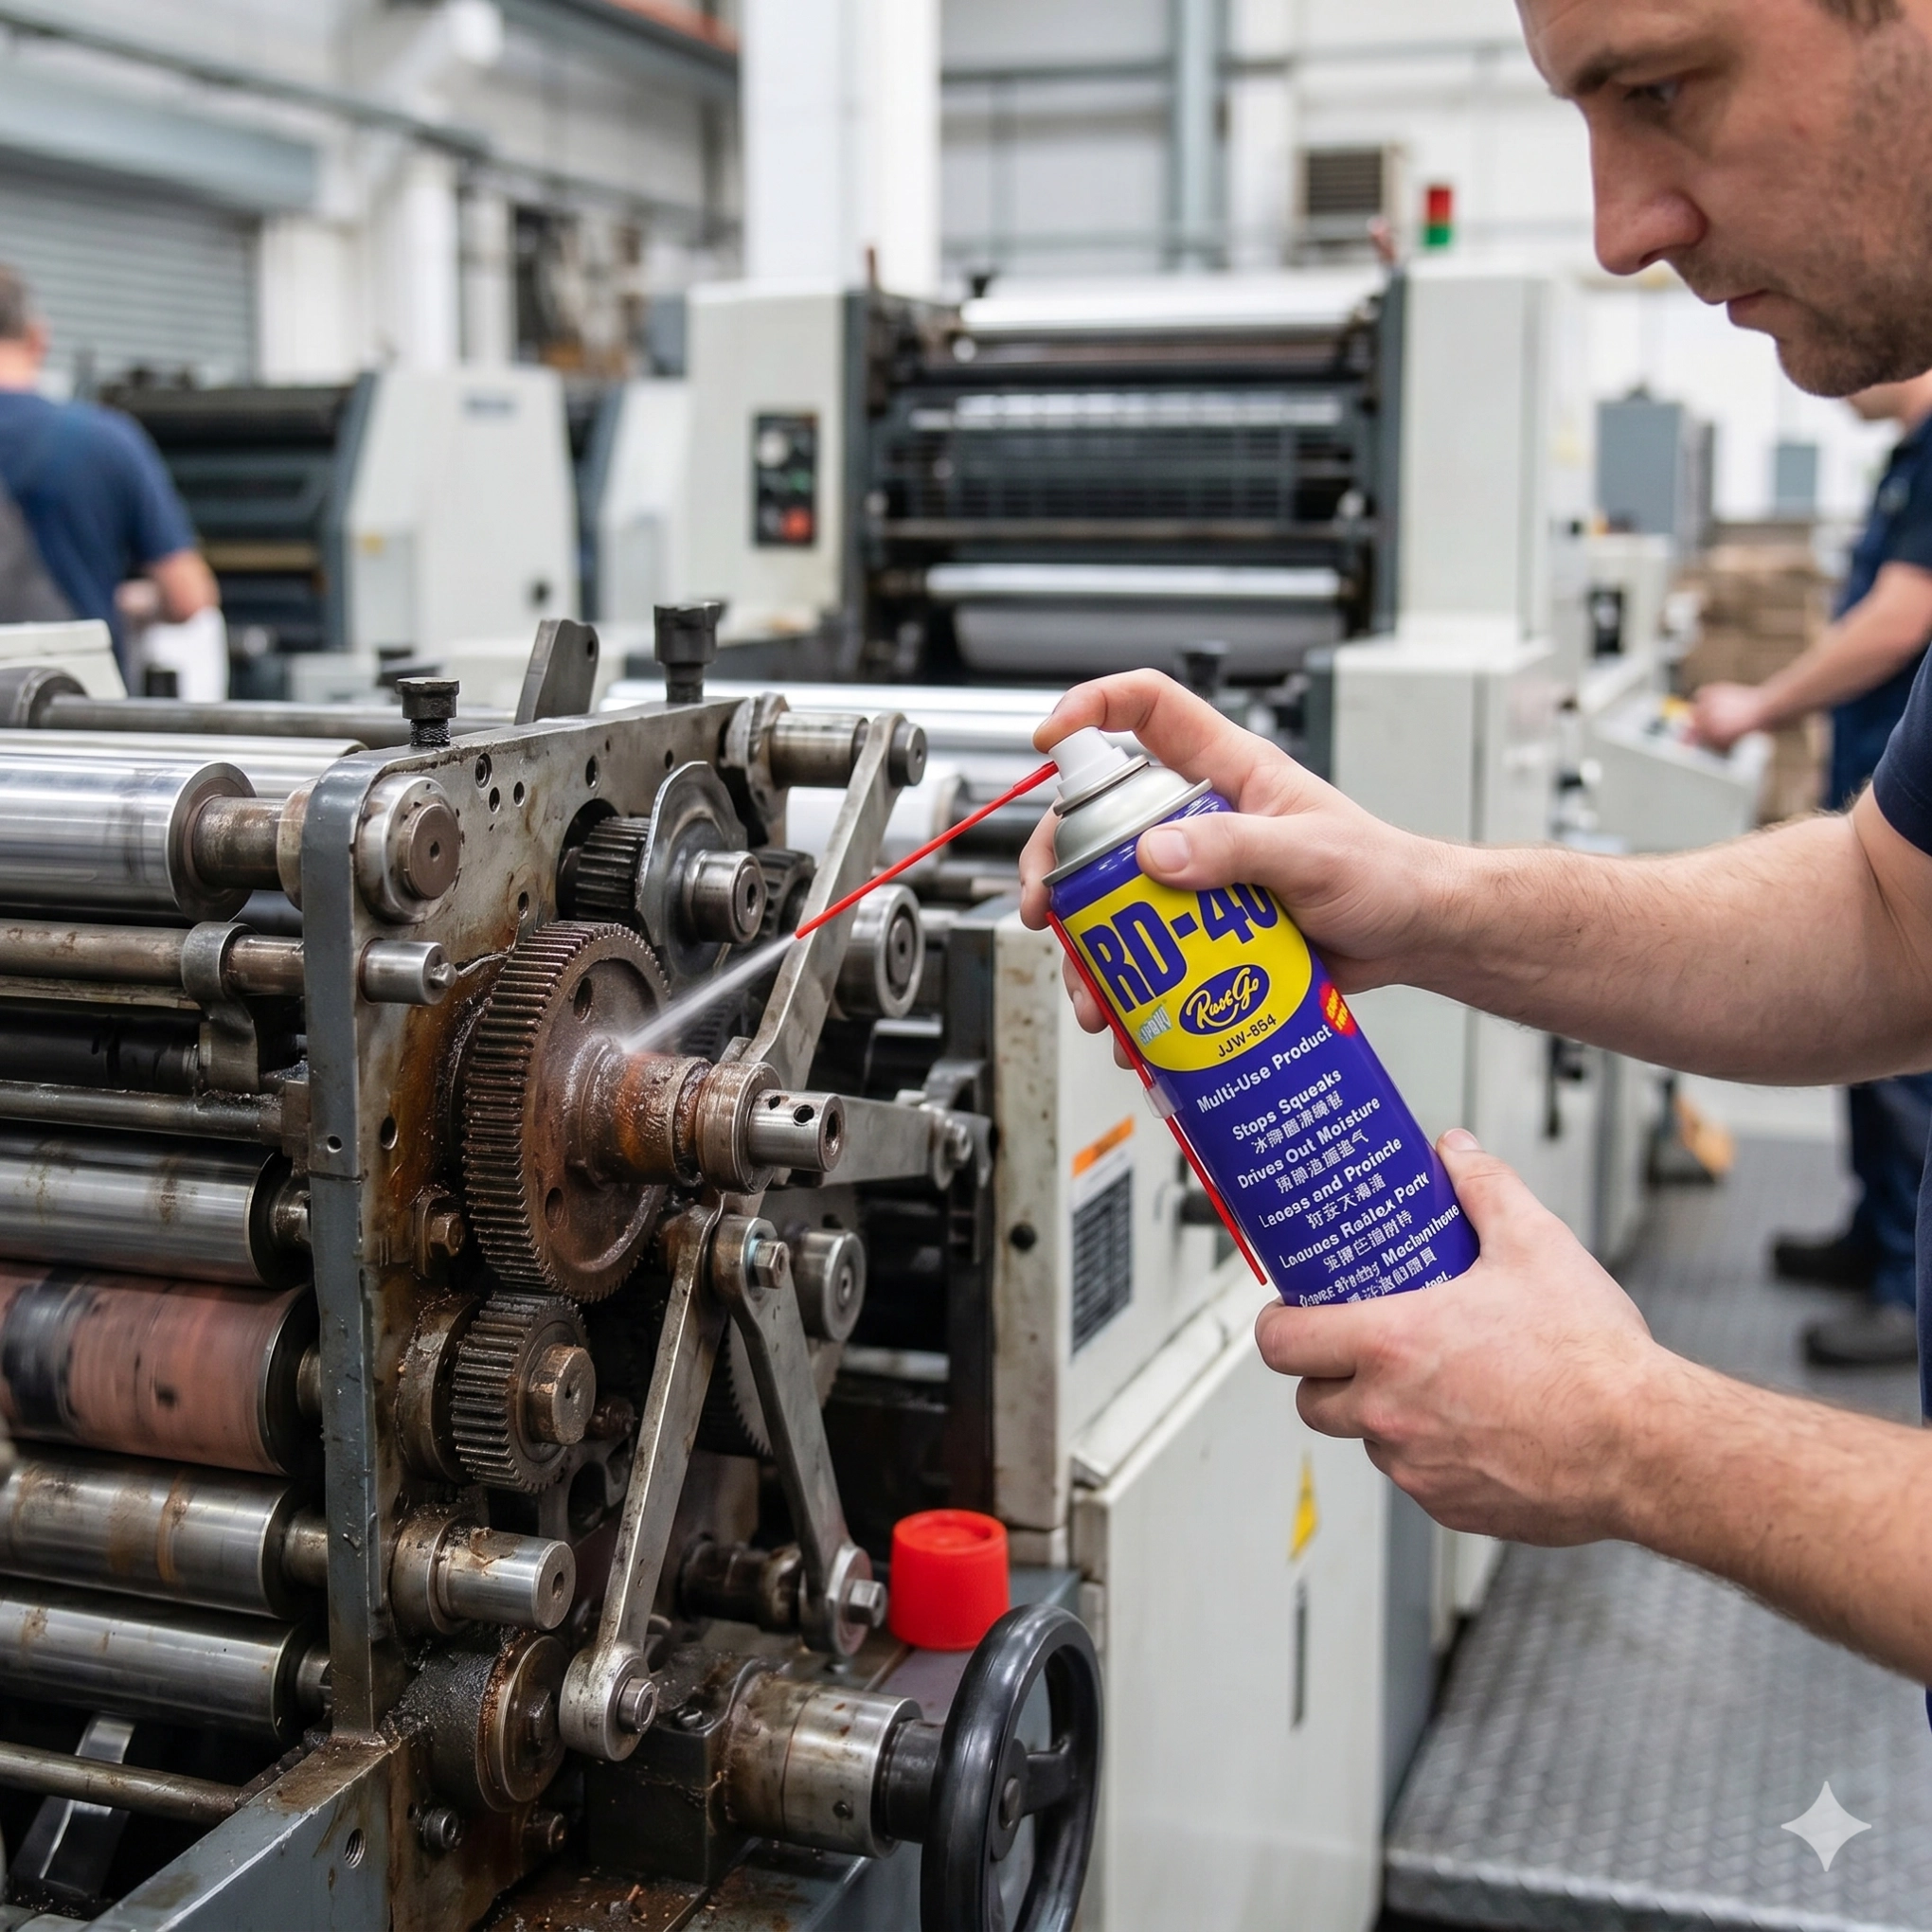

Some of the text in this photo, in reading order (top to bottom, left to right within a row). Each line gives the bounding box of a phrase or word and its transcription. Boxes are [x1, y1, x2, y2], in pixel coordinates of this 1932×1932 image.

[1080, 883, 1278, 1012] RD-40
[1196, 1024, 1333, 1114] Multi-Use Product
[1232, 1110, 1278, 1140] Stops
[1279, 1069, 1342, 1115] Squeaks
[1237, 1158, 1284, 1190] Drives
[1285, 1137, 1316, 1164] Out
[1316, 1097, 1381, 1145] Moisture
[1314, 1174, 1344, 1203] and
